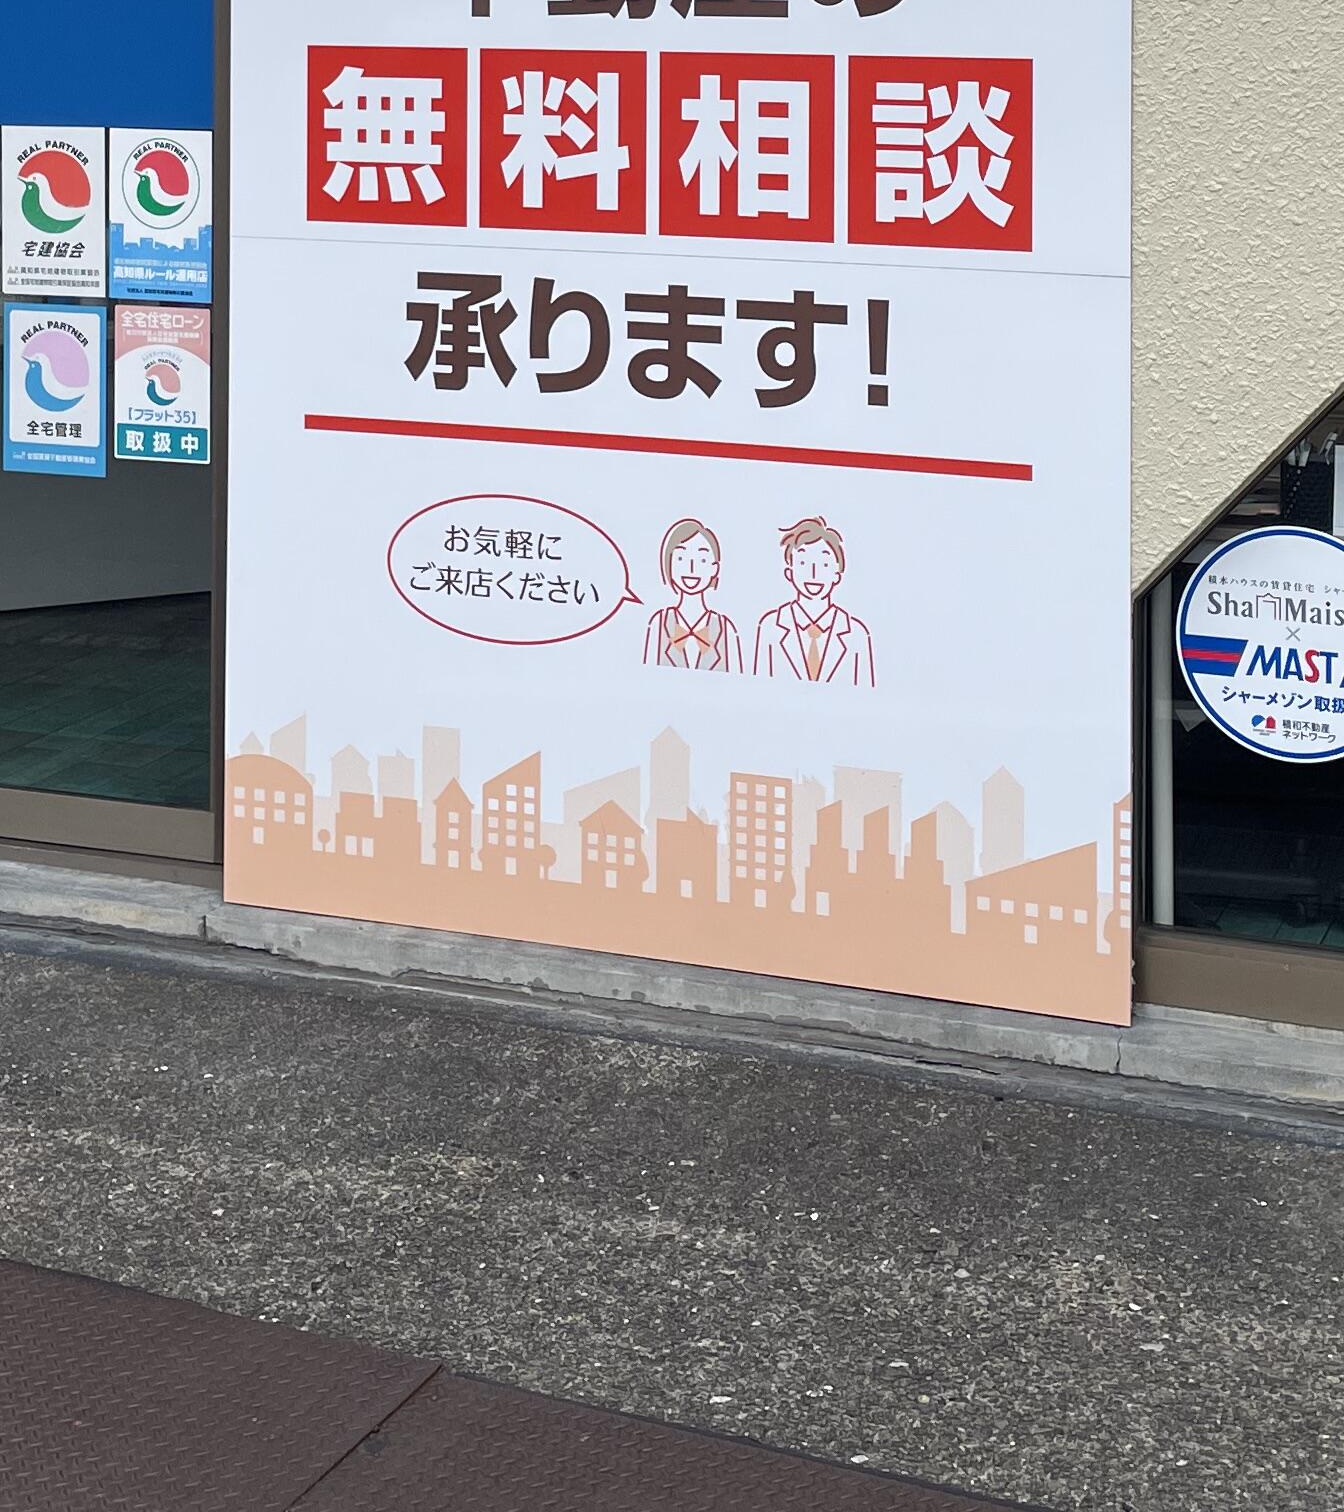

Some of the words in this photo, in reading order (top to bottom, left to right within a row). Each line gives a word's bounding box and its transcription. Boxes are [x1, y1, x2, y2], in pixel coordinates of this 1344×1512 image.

[17, 144, 42, 163] REAL
[45, 140, 89, 166] PARTNER
[133, 143, 152, 161] REAL
[154, 141, 189, 163] PARTNER
[322, 67, 1015, 228] 無料相談
[22, 241, 86, 258] 宅建協会
[121, 310, 205, 330] 全宅住宅ローン
[20, 322, 44, 343] REAL
[47, 320, 89, 347] PARTNER
[26, 420, 82, 439] 全宅管理
[125, 429, 199, 455] 取扱中
[442, 523, 564, 562] お気軽に
[409, 561, 601, 608] ご来店ください
[1246, 645, 1339, 684] MAST
[1282, 731, 1336, 744] ネットワーク
